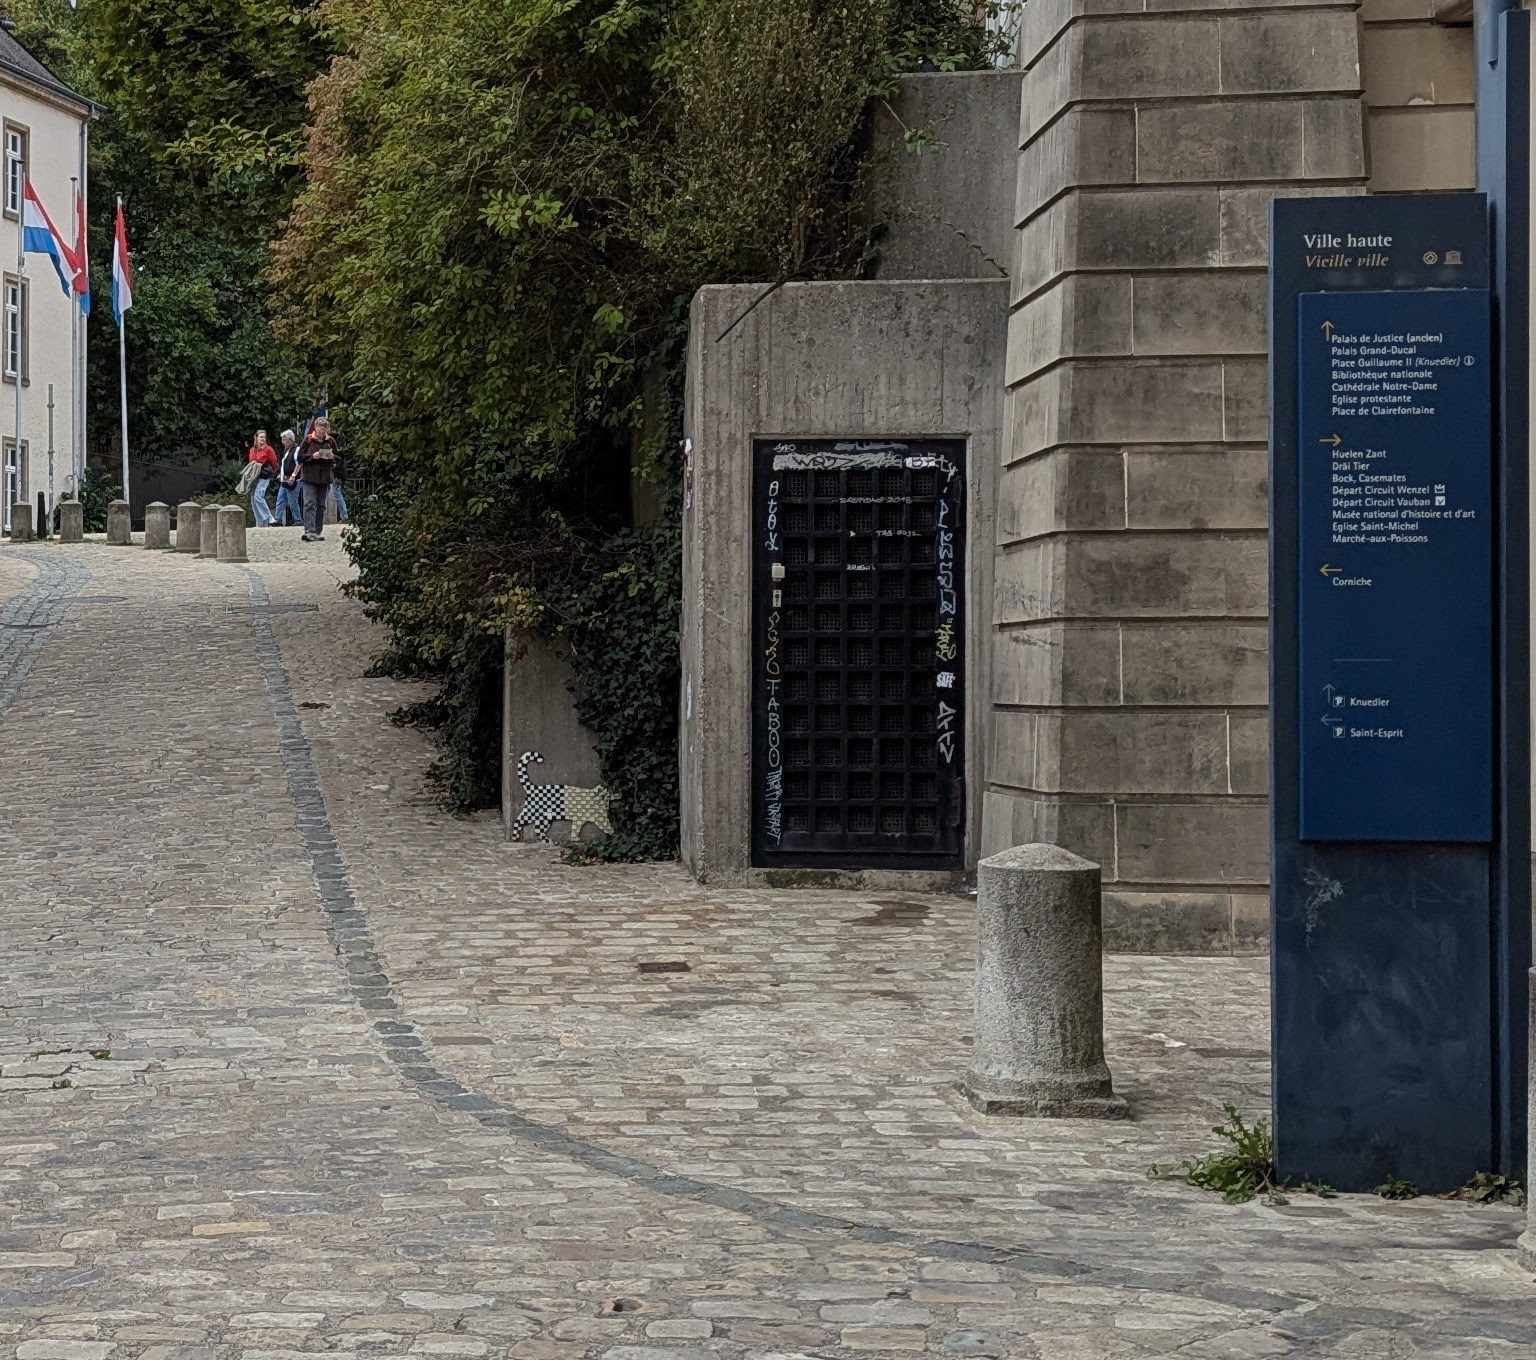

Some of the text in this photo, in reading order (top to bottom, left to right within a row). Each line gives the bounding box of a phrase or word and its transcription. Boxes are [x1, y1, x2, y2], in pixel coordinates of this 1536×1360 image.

[1303, 233, 1393, 249] Ville haute
[1305, 253, 1390, 268] Vieille ville
[1331, 332, 1443, 344] Palais de Justice (ancien)
[1331, 345, 1417, 356] Palais Grand-Ducal
[1331, 358, 1356, 368] Place
[1358, 357, 1404, 368] Guillaume
[1331, 369, 1433, 381] Bibliothèque nationale
[1331, 381, 1438, 392] Cathédrale Notre-Dame
[1331, 394, 1412, 406] Eglise protestante
[1331, 405, 1435, 416] Place de Clairefontaine
[1332, 449, 1387, 459] Huelen Zant
[1353, 461, 1371, 471] Tier
[1332, 473, 1407, 484] Bock, Casemates
[1332, 485, 1430, 496] Départ Circuit Wenzel
[1332, 497, 1431, 509] Départ Circuit Vauban
[1332, 509, 1361, 519] Musée
[1362, 509, 1399, 519] national
[1443, 509, 1453, 519] et
[1332, 521, 1419, 533] Eglise Saint-Michel
[1332, 533, 1429, 544] Marché-aux-Poissons
[1332, 576, 1373, 587] Corniche
[1349, 697, 1391, 707] Knuedler
[1349, 727, 1404, 740] Saint-Esprit
